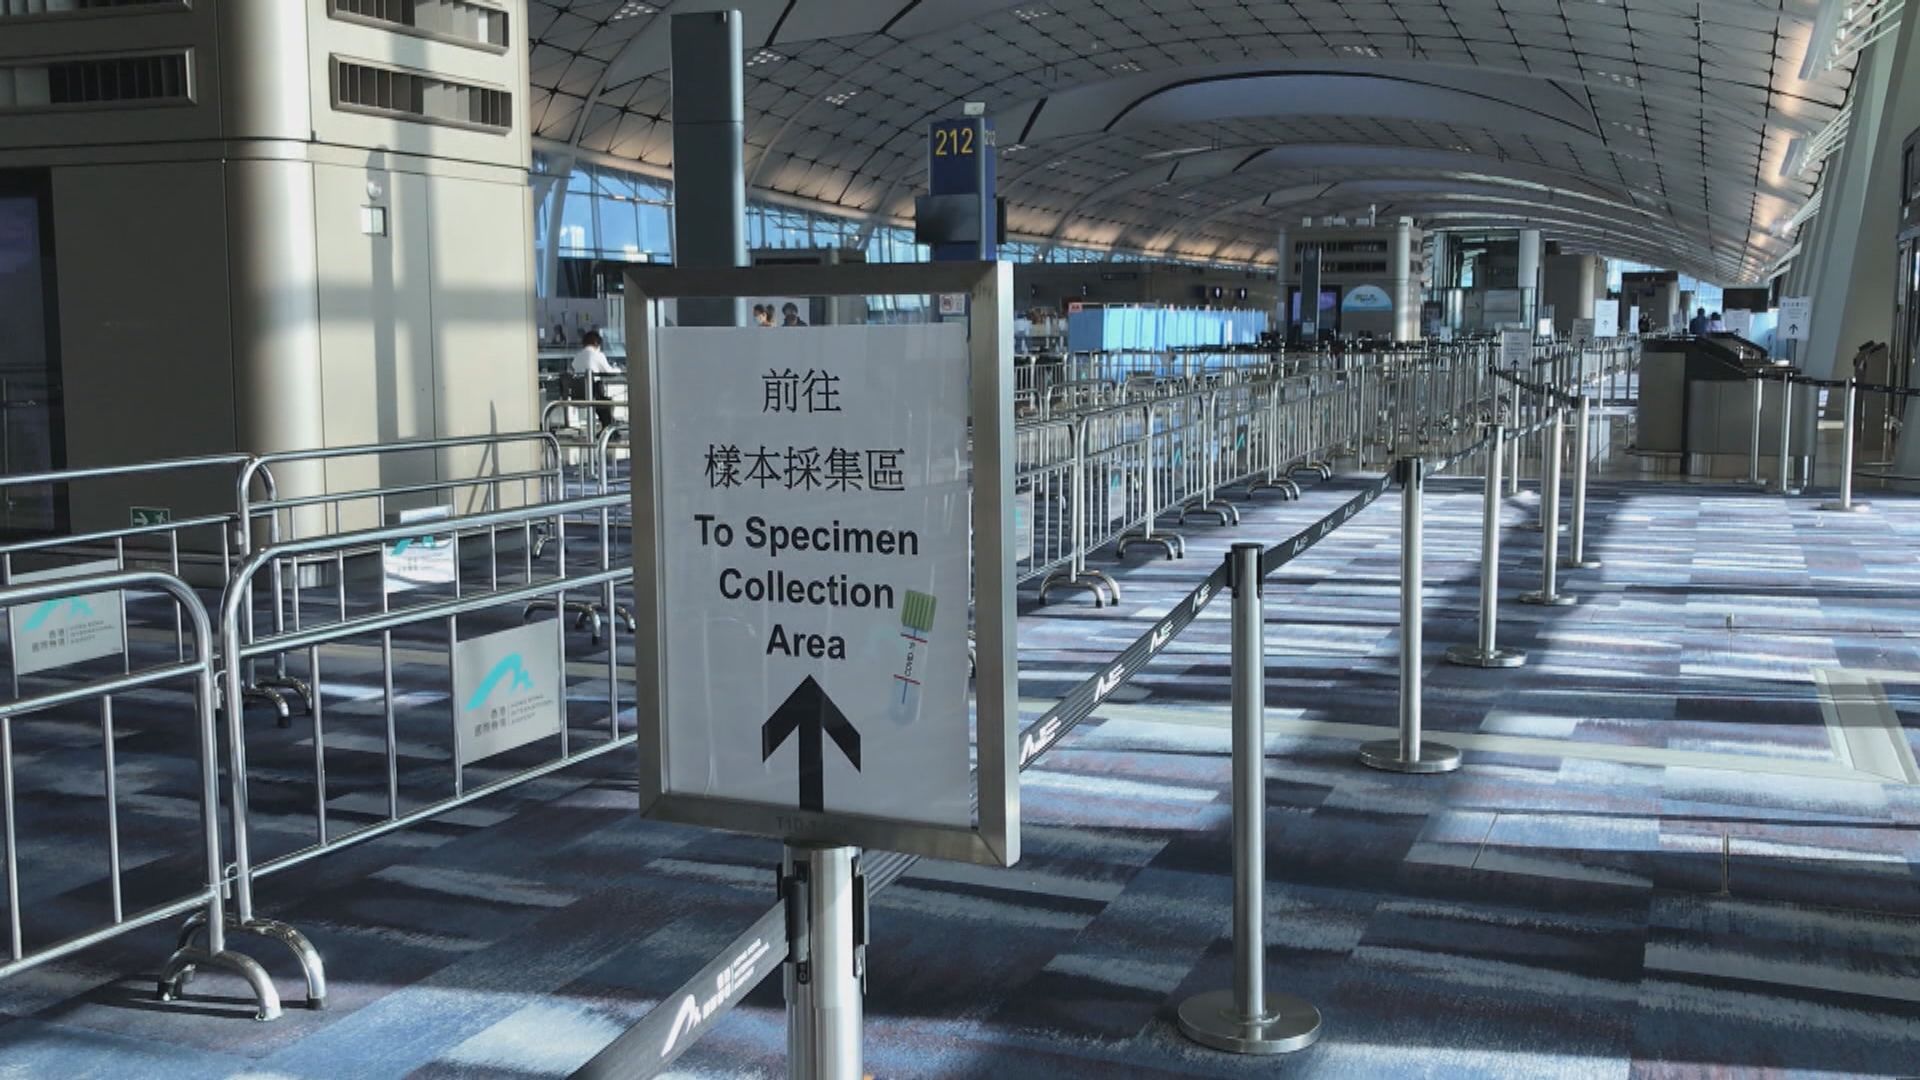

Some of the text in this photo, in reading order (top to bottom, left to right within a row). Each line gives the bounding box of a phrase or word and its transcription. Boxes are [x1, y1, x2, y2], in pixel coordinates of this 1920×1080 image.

[935, 127, 973, 156] 212
[761, 367, 842, 414] 前往
[704, 443, 906, 492] 樣本採集區
[694, 514, 919, 557] To Specimen
[719, 567, 894, 609] Collection
[766, 624, 847, 660] Area
